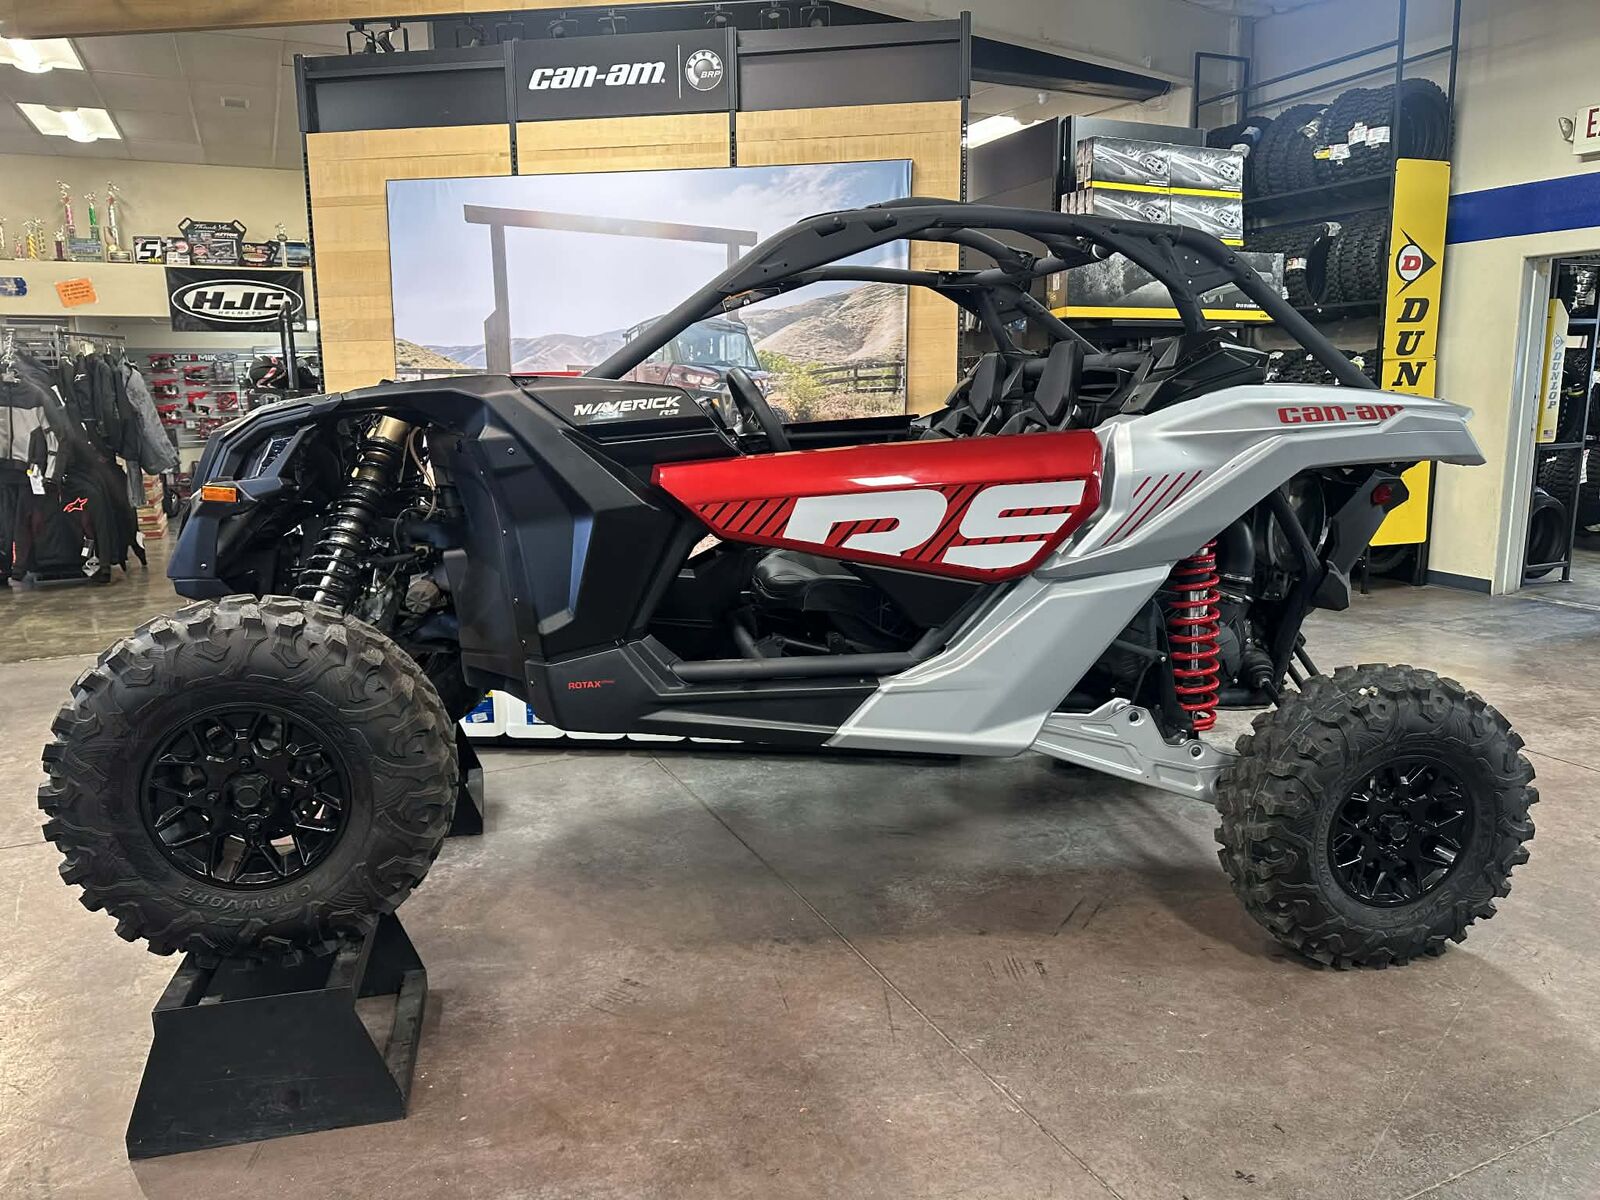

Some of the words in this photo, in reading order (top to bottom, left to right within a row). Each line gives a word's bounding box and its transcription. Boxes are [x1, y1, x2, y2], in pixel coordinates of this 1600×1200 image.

[528, 61, 666, 91] can-am
[700, 70, 721, 79] BRP
[1586, 107, 1600, 138] E
[1400, 255, 1422, 271] D
[191, 291, 285, 310] HJC
[1390, 297, 1430, 395] DUN
[1547, 352, 1562, 409] DUNLOP
[573, 395, 682, 416] MAVERICK
[659, 408, 680, 416] RS
[1277, 404, 1405, 424] can-am
[782, 479, 1087, 569] RS
[567, 681, 602, 690] ROTAX
